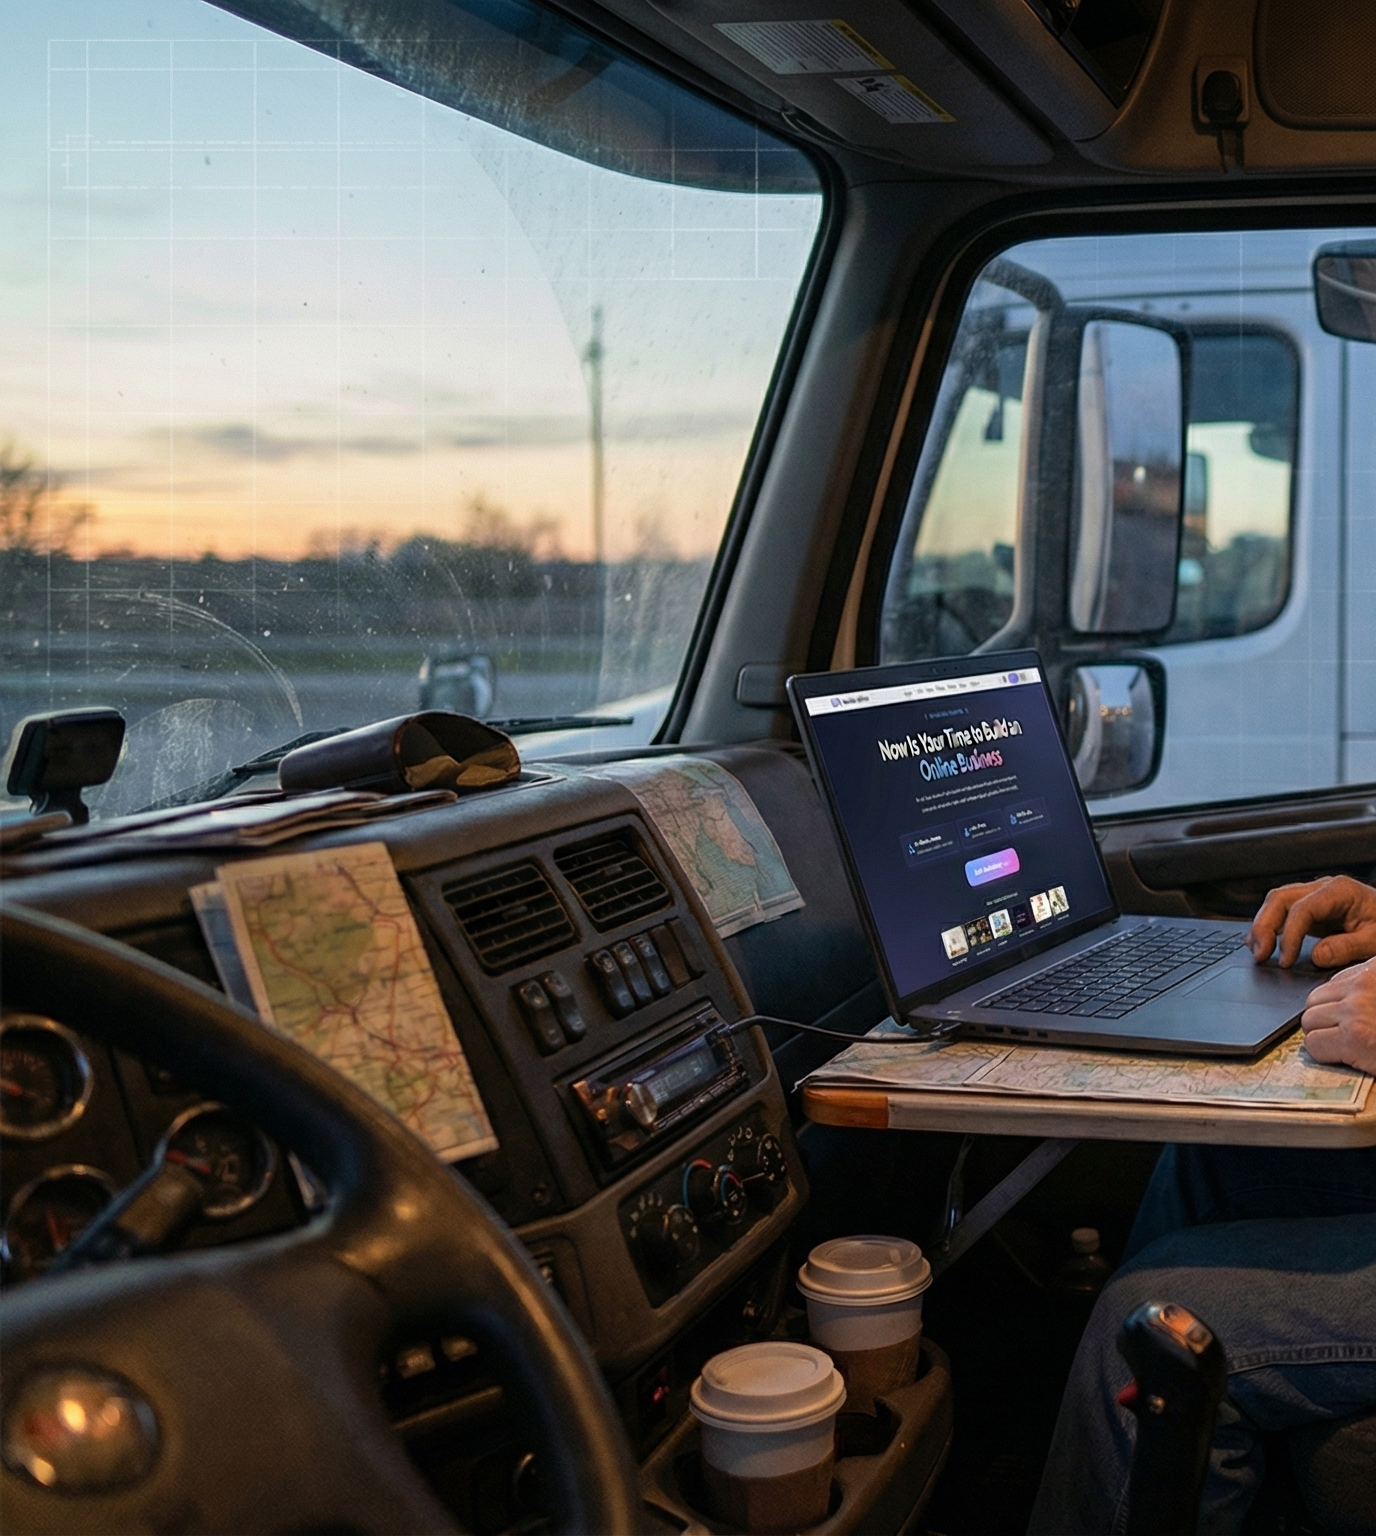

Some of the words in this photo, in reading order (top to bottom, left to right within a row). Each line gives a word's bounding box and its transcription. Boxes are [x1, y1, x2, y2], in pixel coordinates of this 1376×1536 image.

[878, 739, 910, 761] Now
[906, 735, 920, 757] Is
[917, 732, 945, 754] Your
[943, 727, 973, 749] Time
[970, 725, 983, 744] to
[919, 756, 959, 782] Online
[956, 748, 1004, 773] Business
